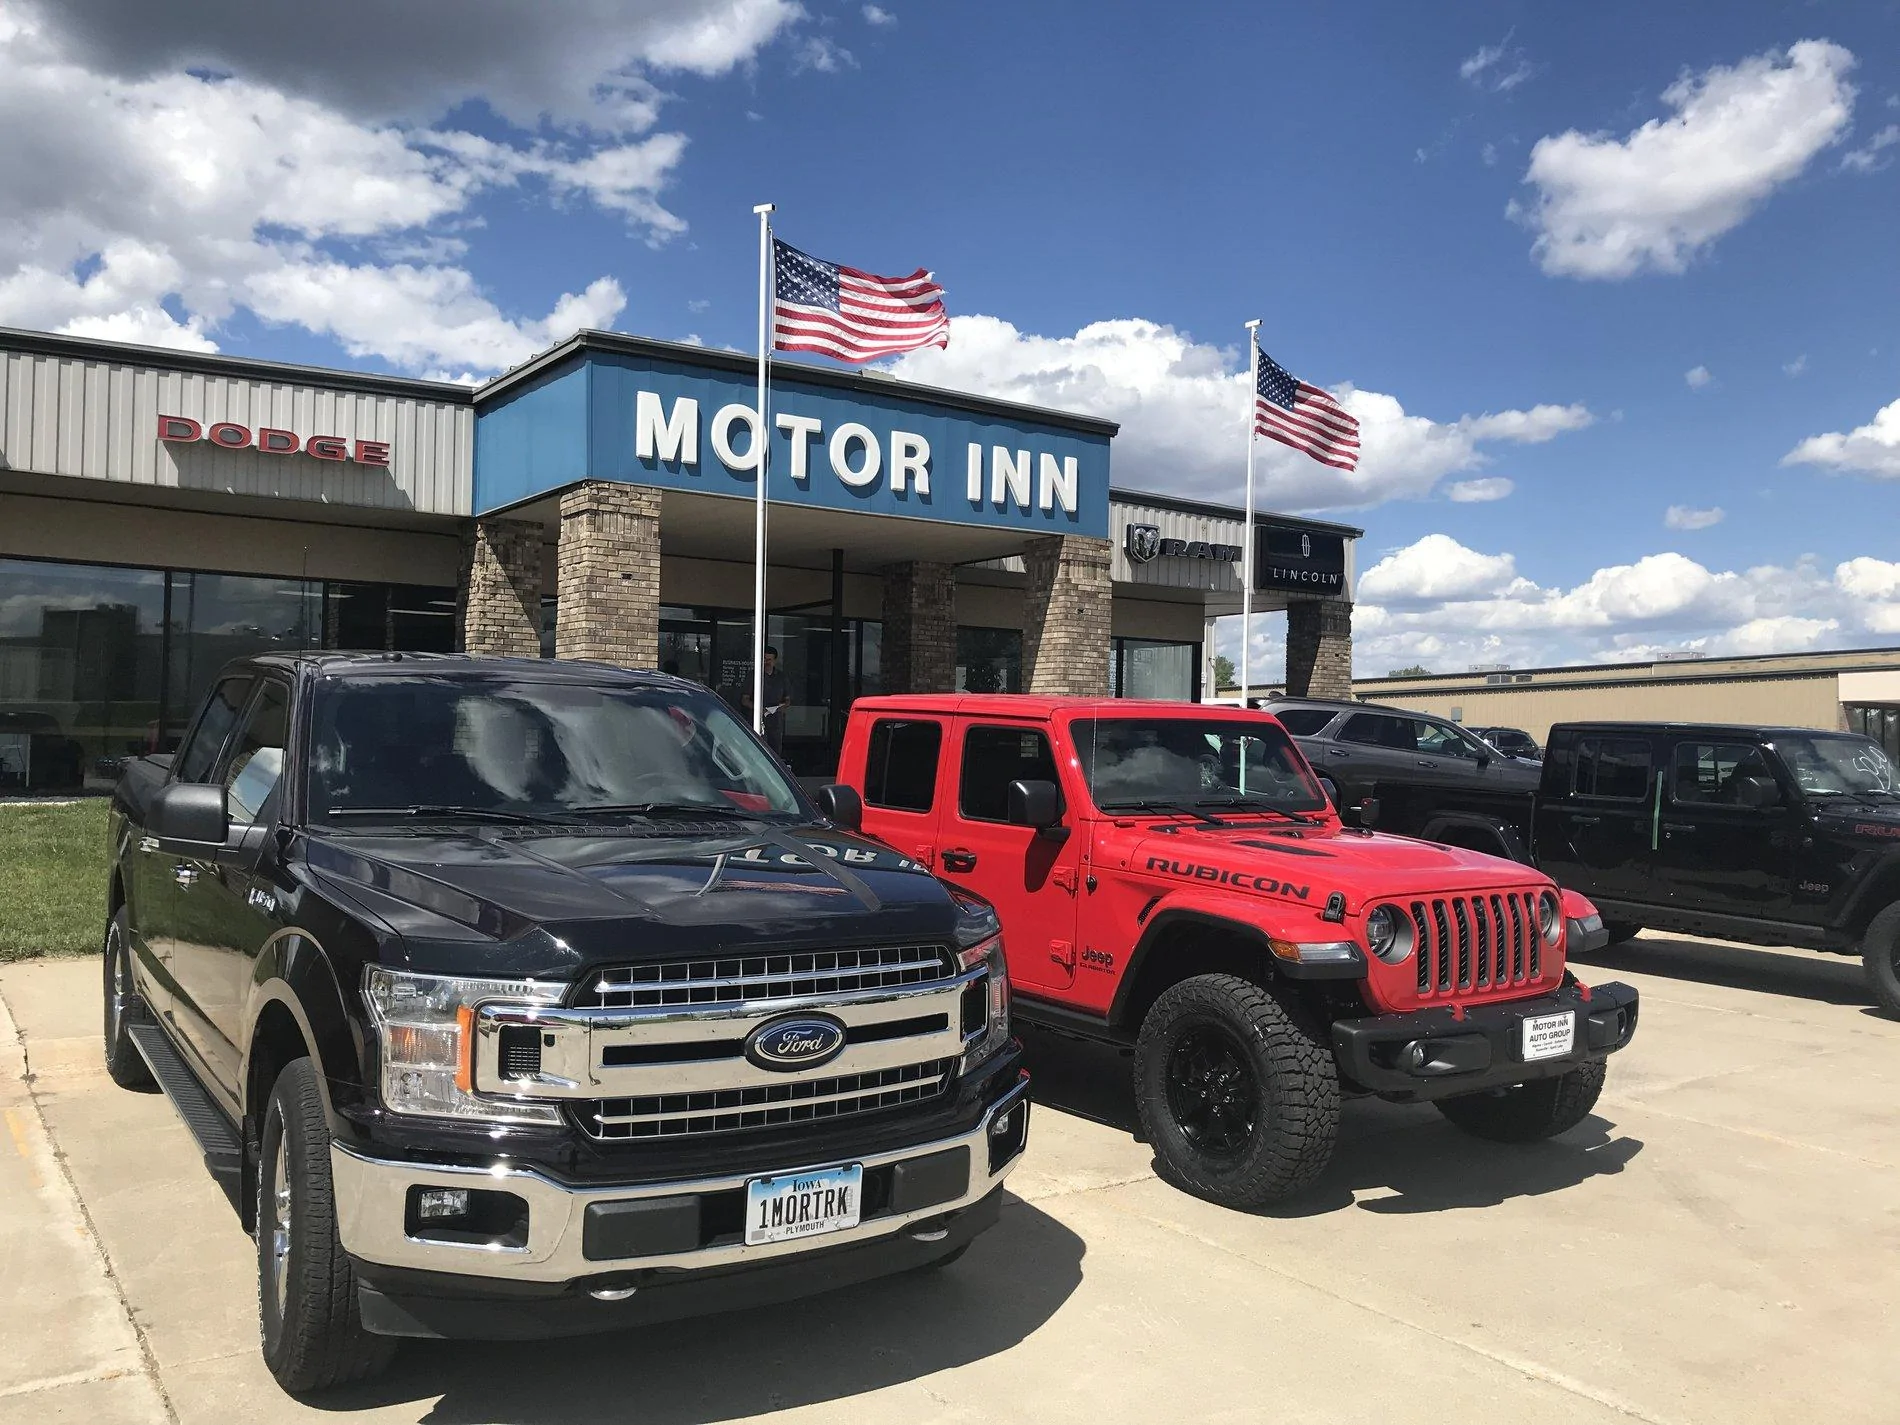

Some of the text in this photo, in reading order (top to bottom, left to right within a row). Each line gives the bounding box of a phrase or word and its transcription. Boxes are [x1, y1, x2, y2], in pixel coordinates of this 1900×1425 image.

[158, 414, 390, 467] DODGE
[635, 390, 1078, 513] MOTOR INN
[1160, 537, 1243, 562] RAM
[1273, 567, 1338, 585] LINCOLN
[1146, 857, 1310, 900] RUBICON
[1800, 881, 1829, 894] Jeep
[1081, 945, 1114, 968] Jeep
[1529, 1029, 1571, 1043] AUTO GROUP
[1532, 1018, 1569, 1031] MOTOR INN
[777, 1029, 824, 1054] Ford
[759, 1185, 849, 1229] 1MORTRK
[785, 1220, 825, 1234] PLYMOUTH
